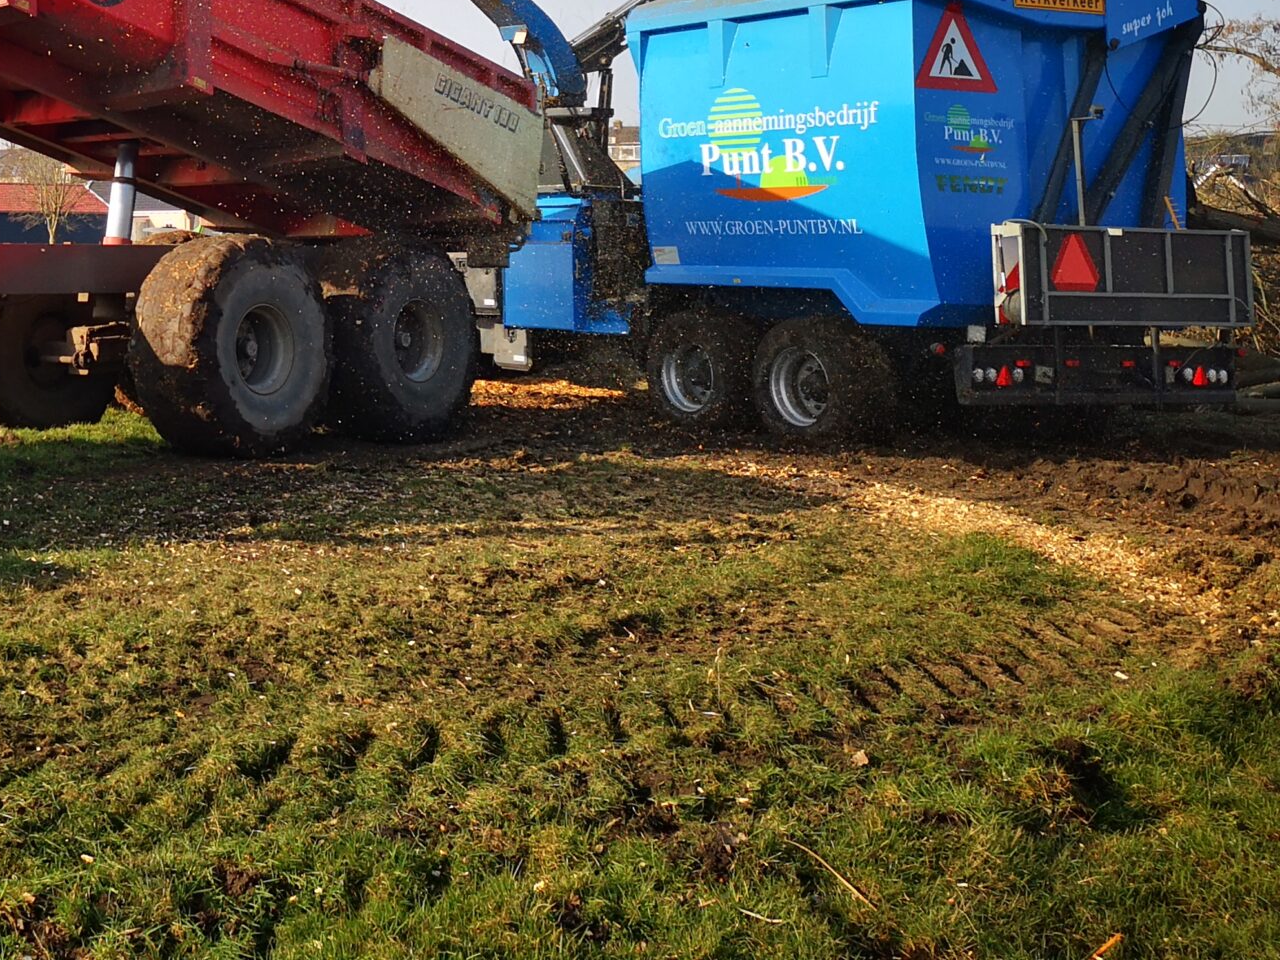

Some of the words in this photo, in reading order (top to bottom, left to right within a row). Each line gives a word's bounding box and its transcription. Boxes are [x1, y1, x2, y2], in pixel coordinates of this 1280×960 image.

[1122, 13, 1152, 36] super
[434, 73, 494, 119] GIGANT
[658, 117, 707, 139] Groen
[714, 101, 879, 134] aannemingsbedrijf
[943, 125, 975, 142] Punt
[979, 128, 1003, 144] B.V.
[700, 142, 773, 176] Punt
[782, 135, 845, 173] B.V.
[935, 174, 1008, 194] FENDT
[685, 218, 864, 236] WWW.GROEN-PUNTBV.NL
